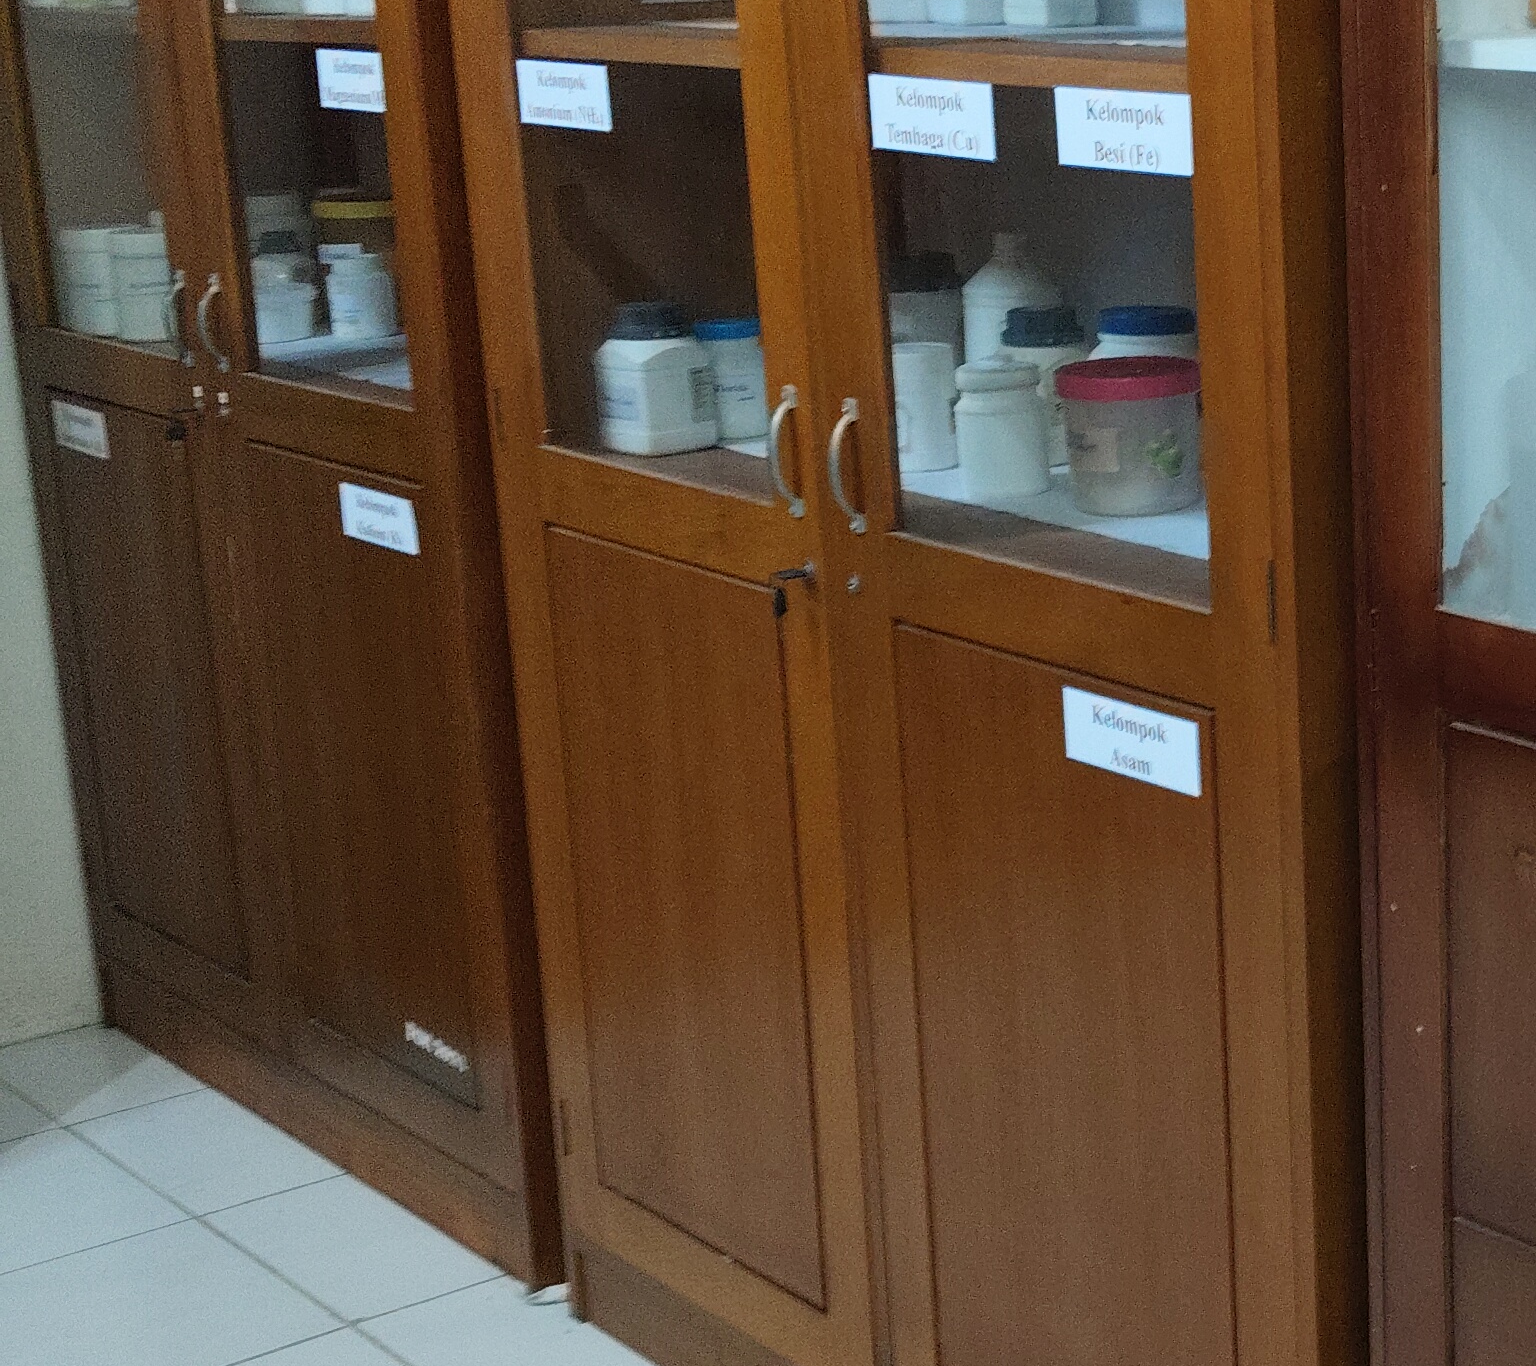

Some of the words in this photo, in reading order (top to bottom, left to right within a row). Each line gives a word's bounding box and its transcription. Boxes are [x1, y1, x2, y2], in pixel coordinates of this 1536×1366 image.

[895, 86, 964, 116] Kelompok
[1085, 98, 1165, 131] Kelompok
[885, 122, 944, 150] Tembaga
[948, 129, 979, 156] (Cu)
[1093, 140, 1125, 163] Besi
[1129, 144, 1160, 172] (Fe)
[1091, 704, 1168, 744] Kelompok
[1110, 747, 1153, 776] Asam
